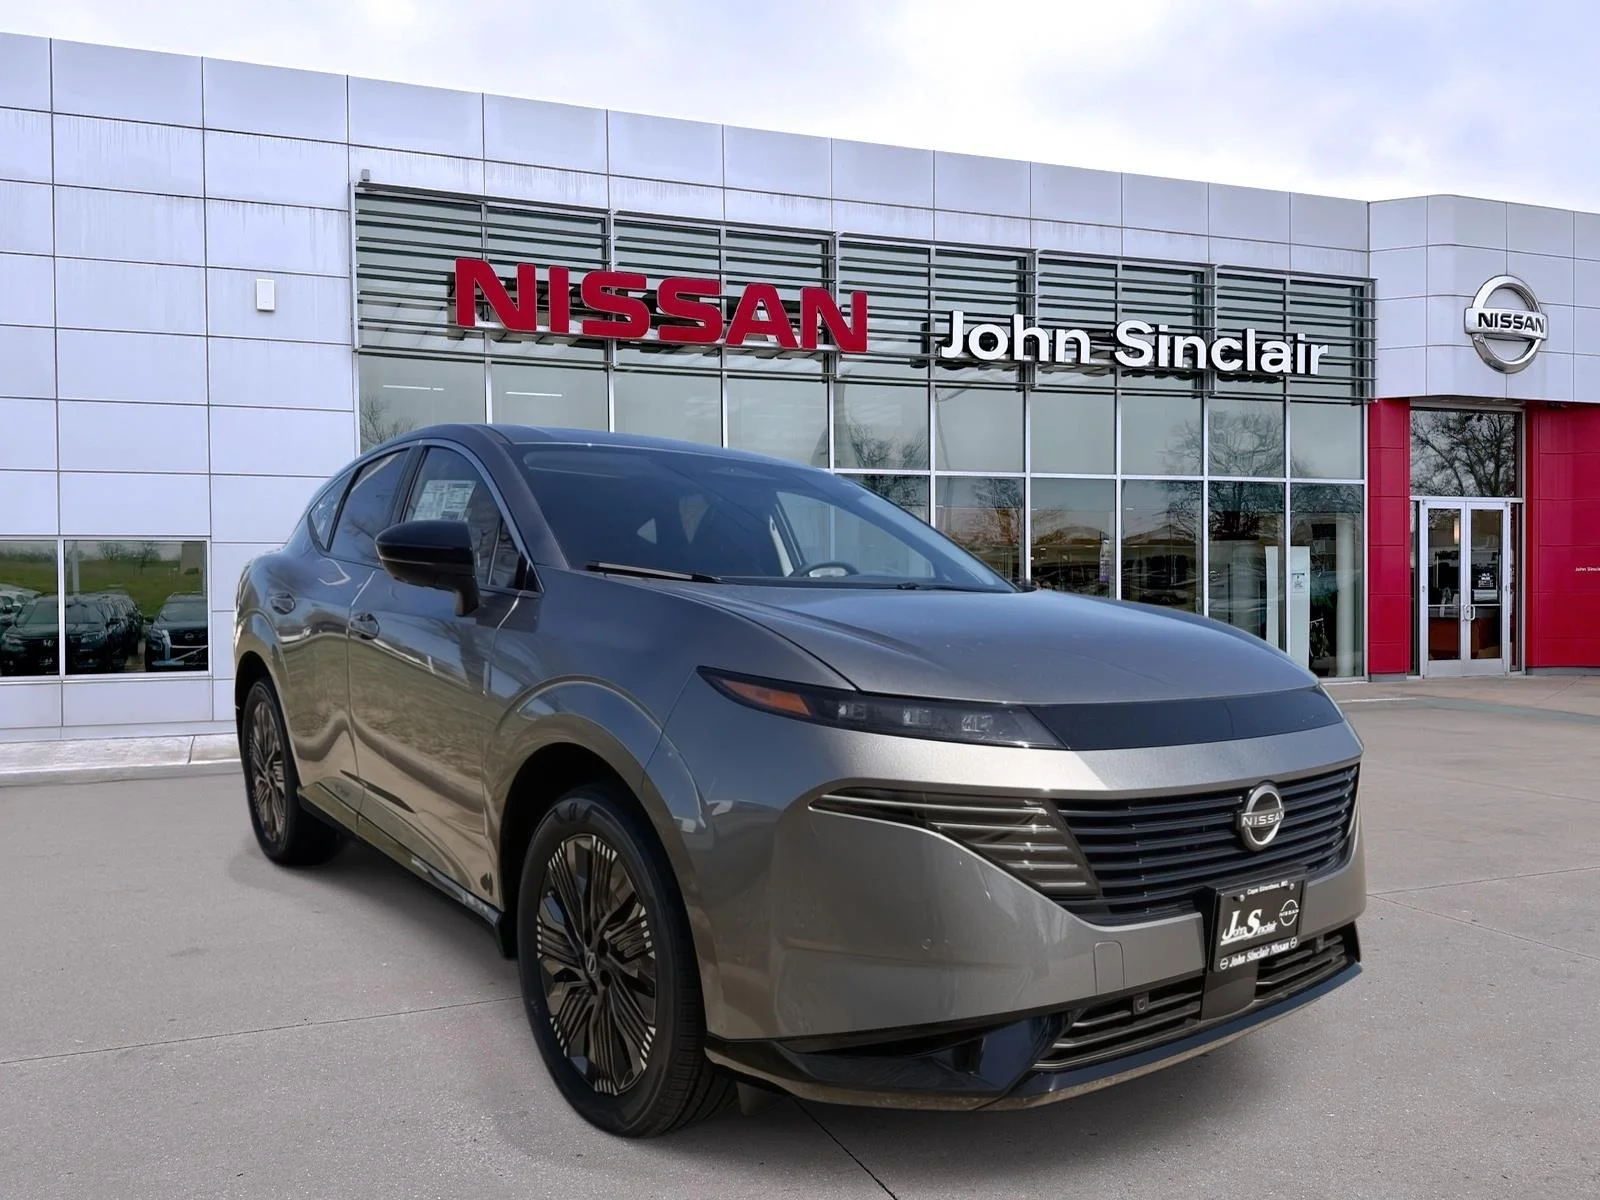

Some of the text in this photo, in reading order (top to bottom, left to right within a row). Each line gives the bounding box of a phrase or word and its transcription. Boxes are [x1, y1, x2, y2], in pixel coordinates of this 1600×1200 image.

[455, 258, 868, 353] NISSAN
[1477, 312, 1545, 333] NISSAN
[941, 310, 1329, 375] John Sinclair
[1242, 811, 1284, 827] NISSAN
[1229, 954, 1246, 967] John
